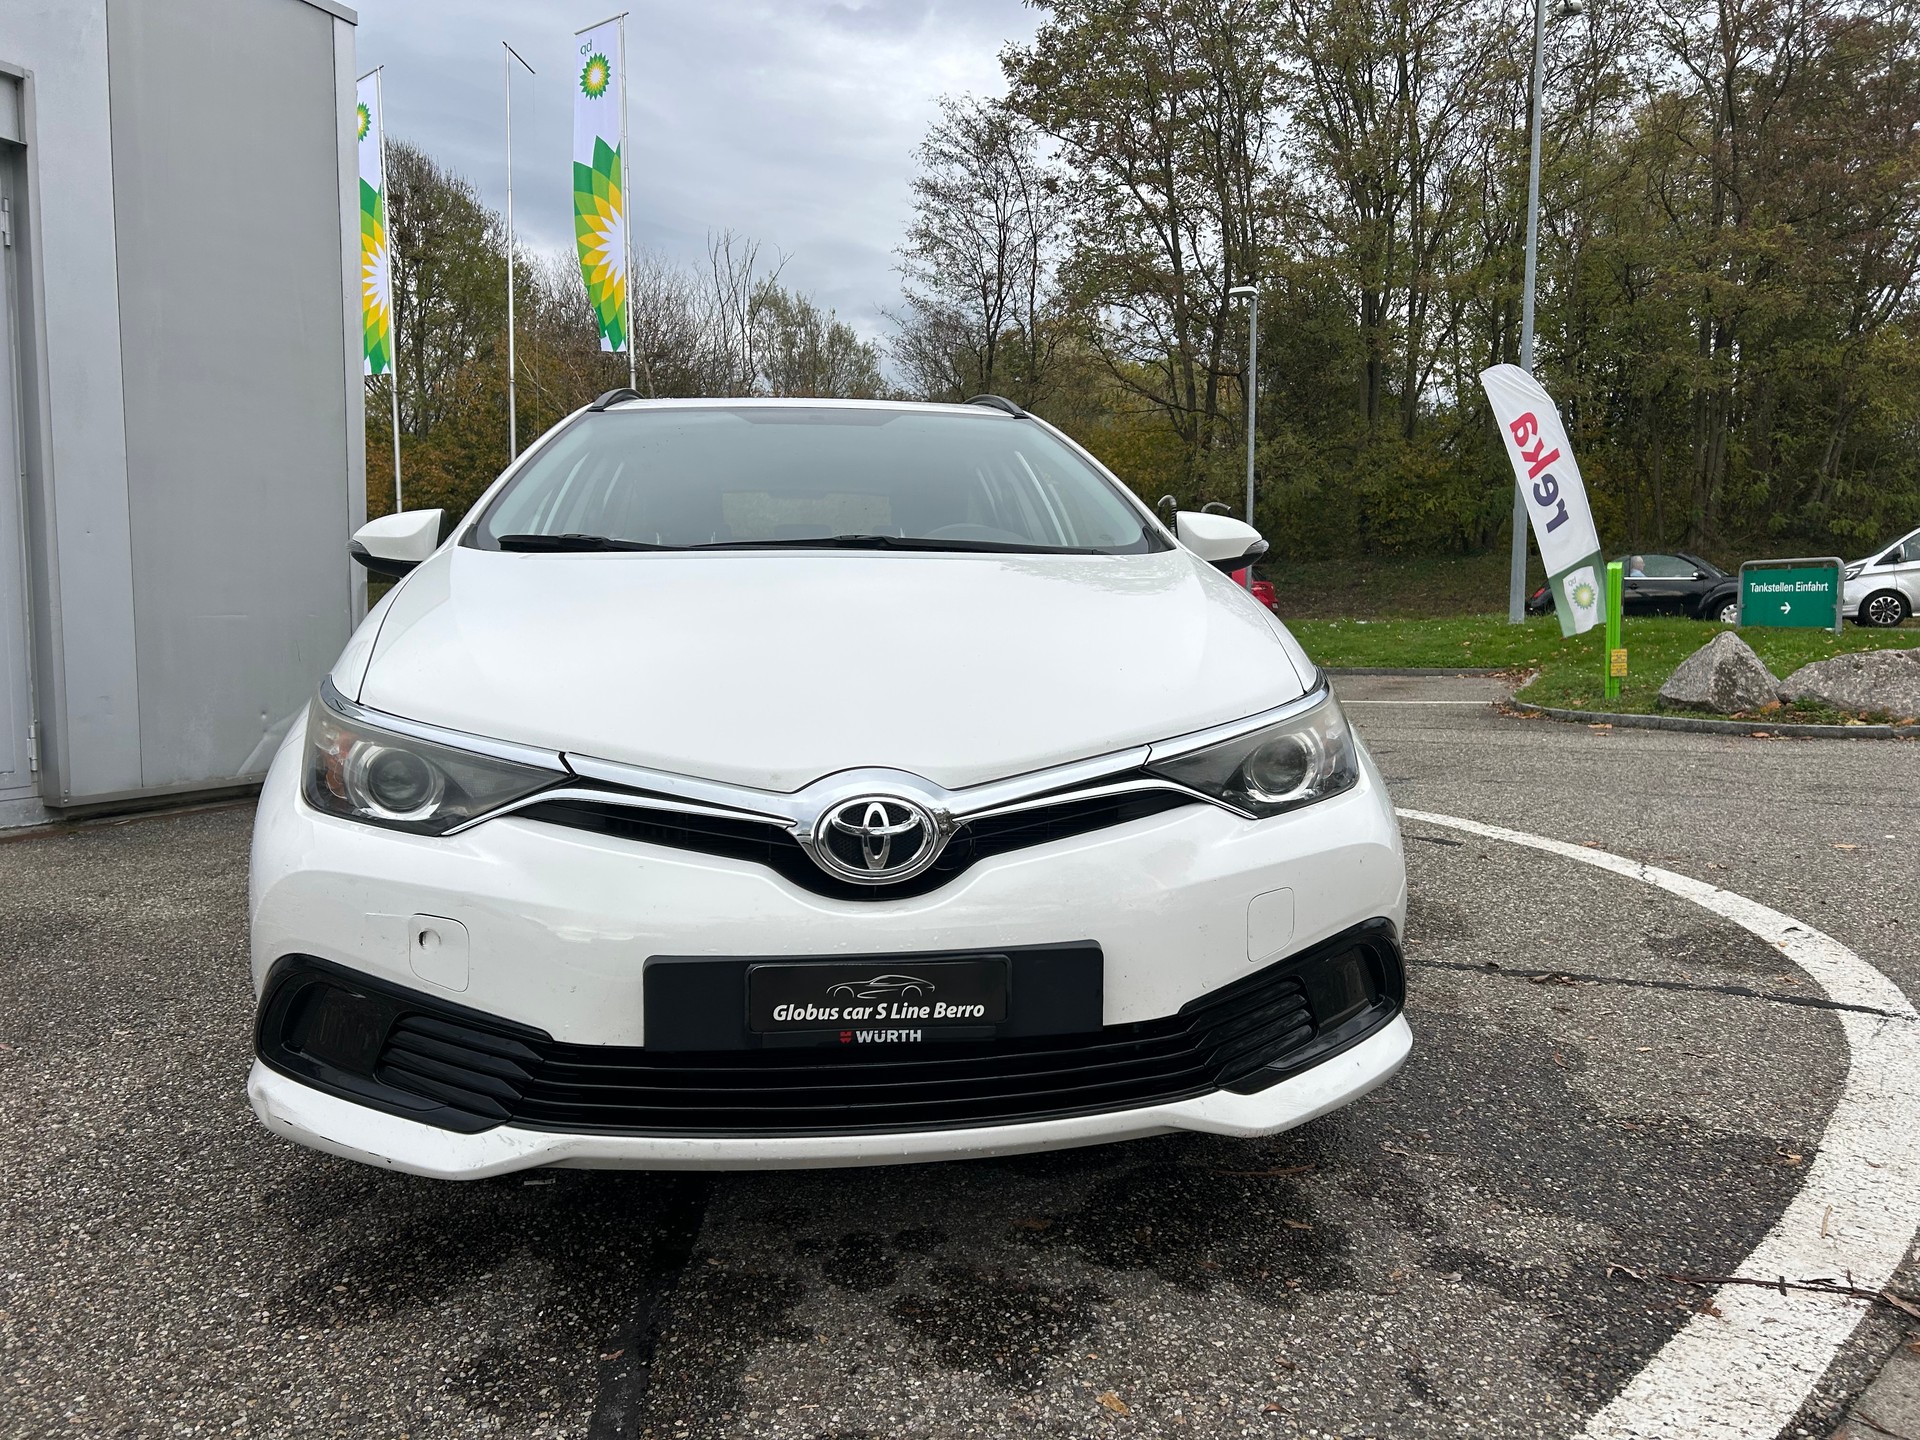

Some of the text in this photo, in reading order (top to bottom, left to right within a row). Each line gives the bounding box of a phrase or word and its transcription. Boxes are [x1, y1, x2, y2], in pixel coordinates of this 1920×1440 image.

[1750, 581, 1829, 593] Tankstellen Einfahrt
[772, 1001, 985, 1021] Globus car S Line Berro
[855, 1029, 922, 1044] WÜRTH
